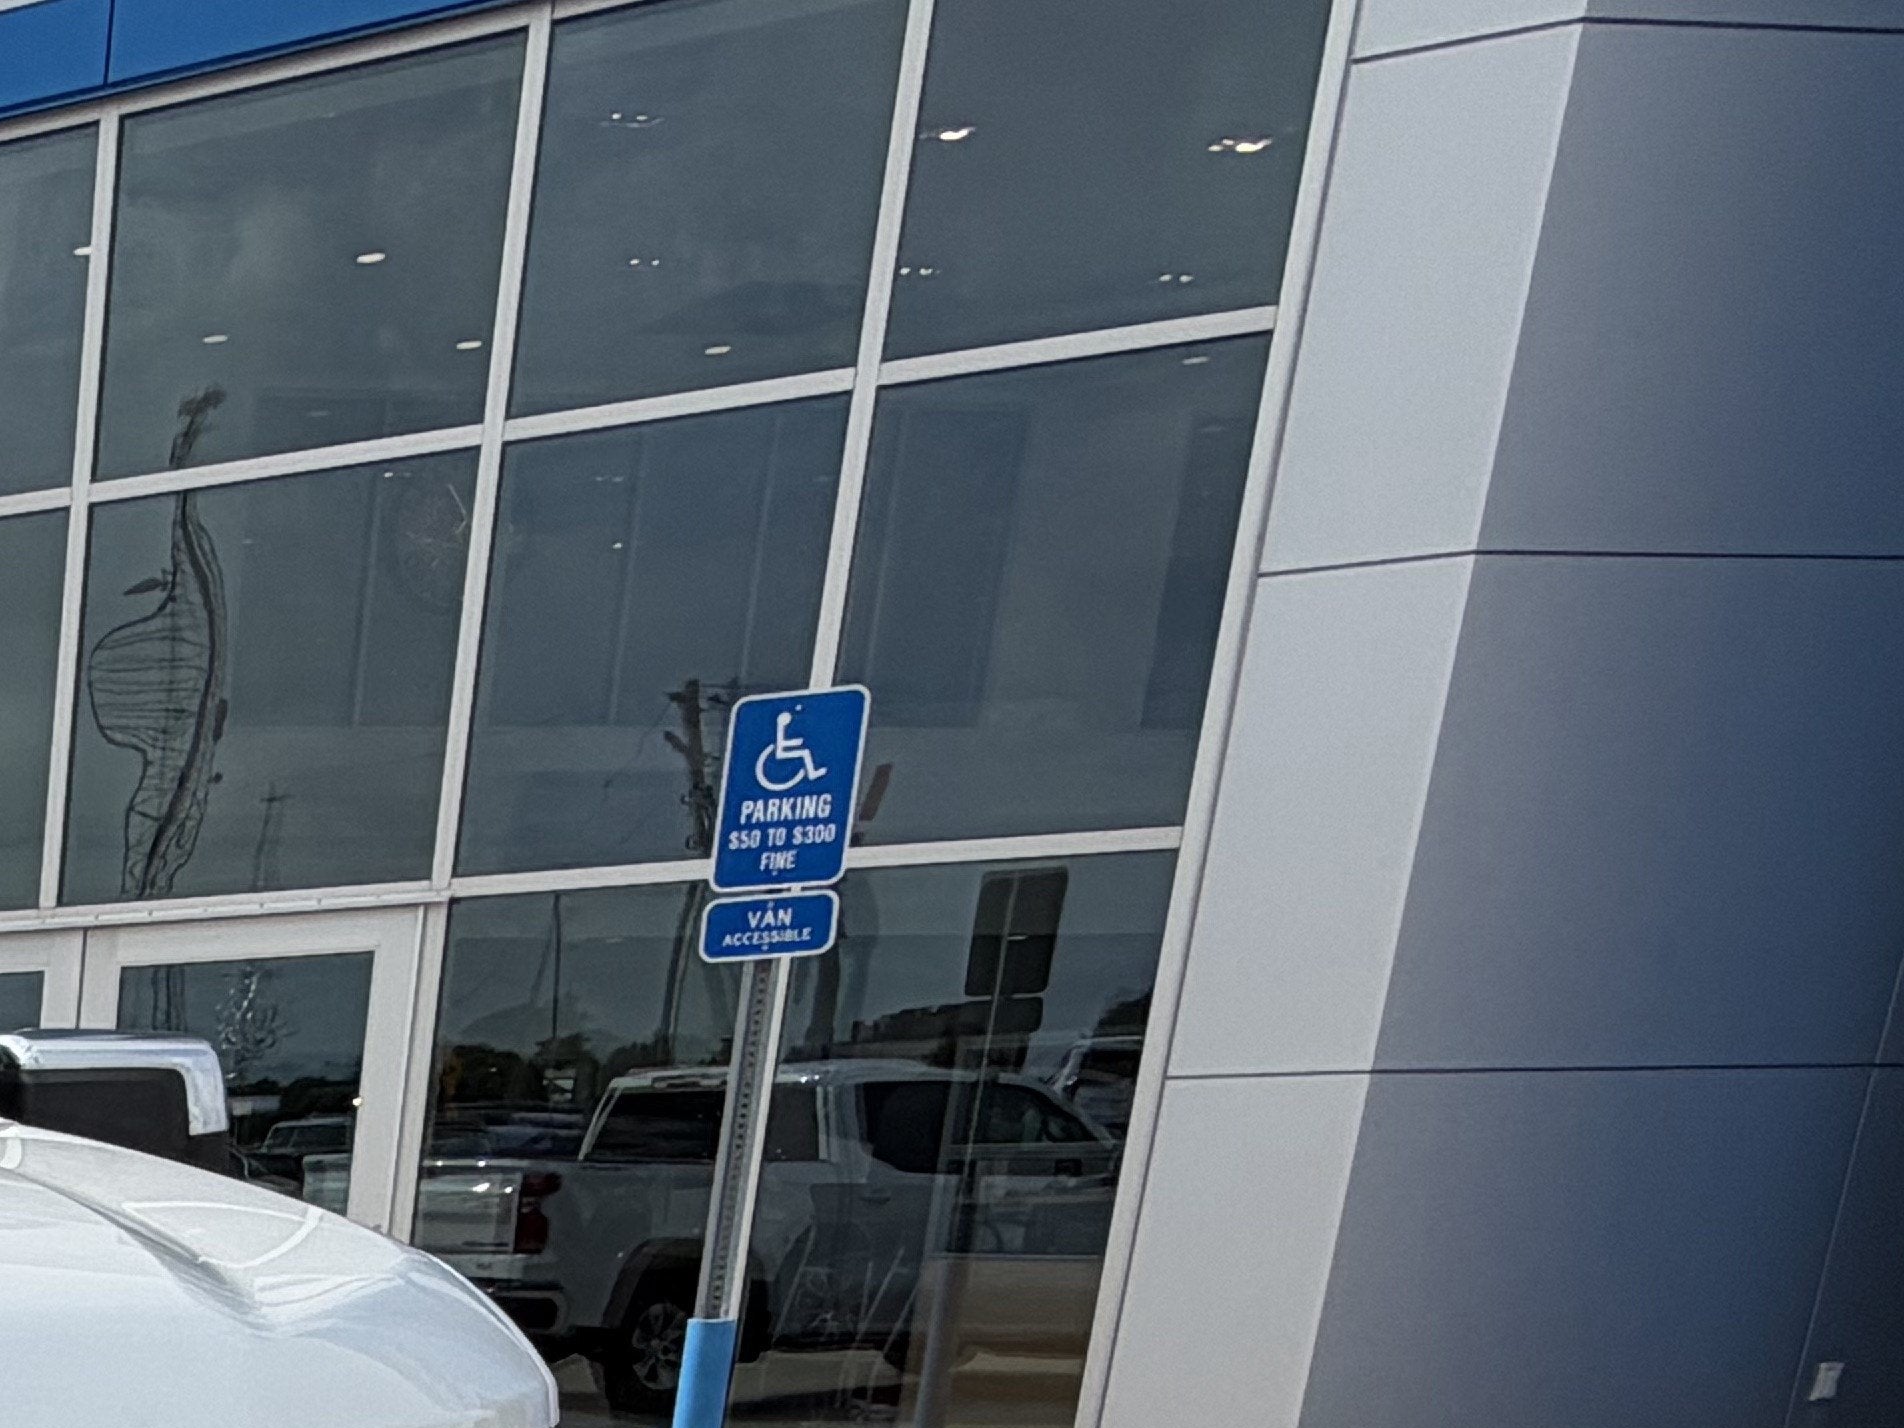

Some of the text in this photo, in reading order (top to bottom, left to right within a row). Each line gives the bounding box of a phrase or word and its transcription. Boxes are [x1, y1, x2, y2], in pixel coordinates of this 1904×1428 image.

[740, 794, 832, 825] PARKING
[768, 827, 787, 846] TO
[760, 851, 797, 871] FINE
[748, 908, 792, 928] VAN
[722, 927, 812, 947] ACCESSIBLE
